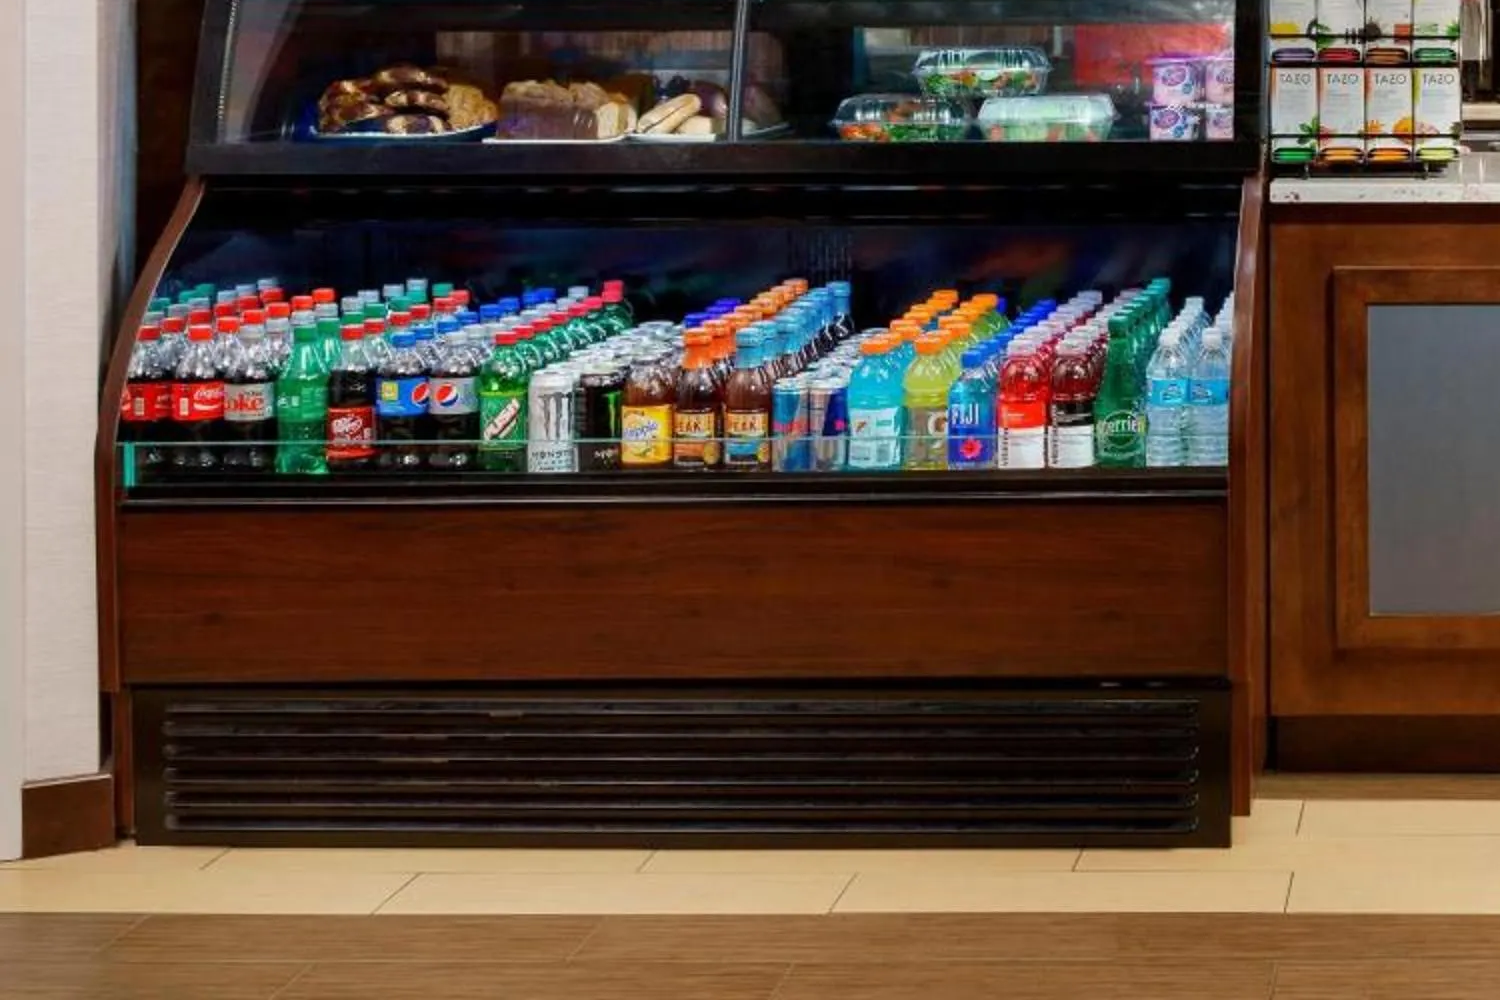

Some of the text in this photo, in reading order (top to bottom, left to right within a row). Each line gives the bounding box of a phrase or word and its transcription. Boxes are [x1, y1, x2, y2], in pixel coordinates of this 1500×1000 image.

[1279, 74, 1312, 85] TAZO
[1327, 74, 1359, 85] TAZO
[1374, 74, 1407, 85] TAZO
[1422, 74, 1455, 85] TAZO
[951, 403, 979, 425] FIJI
